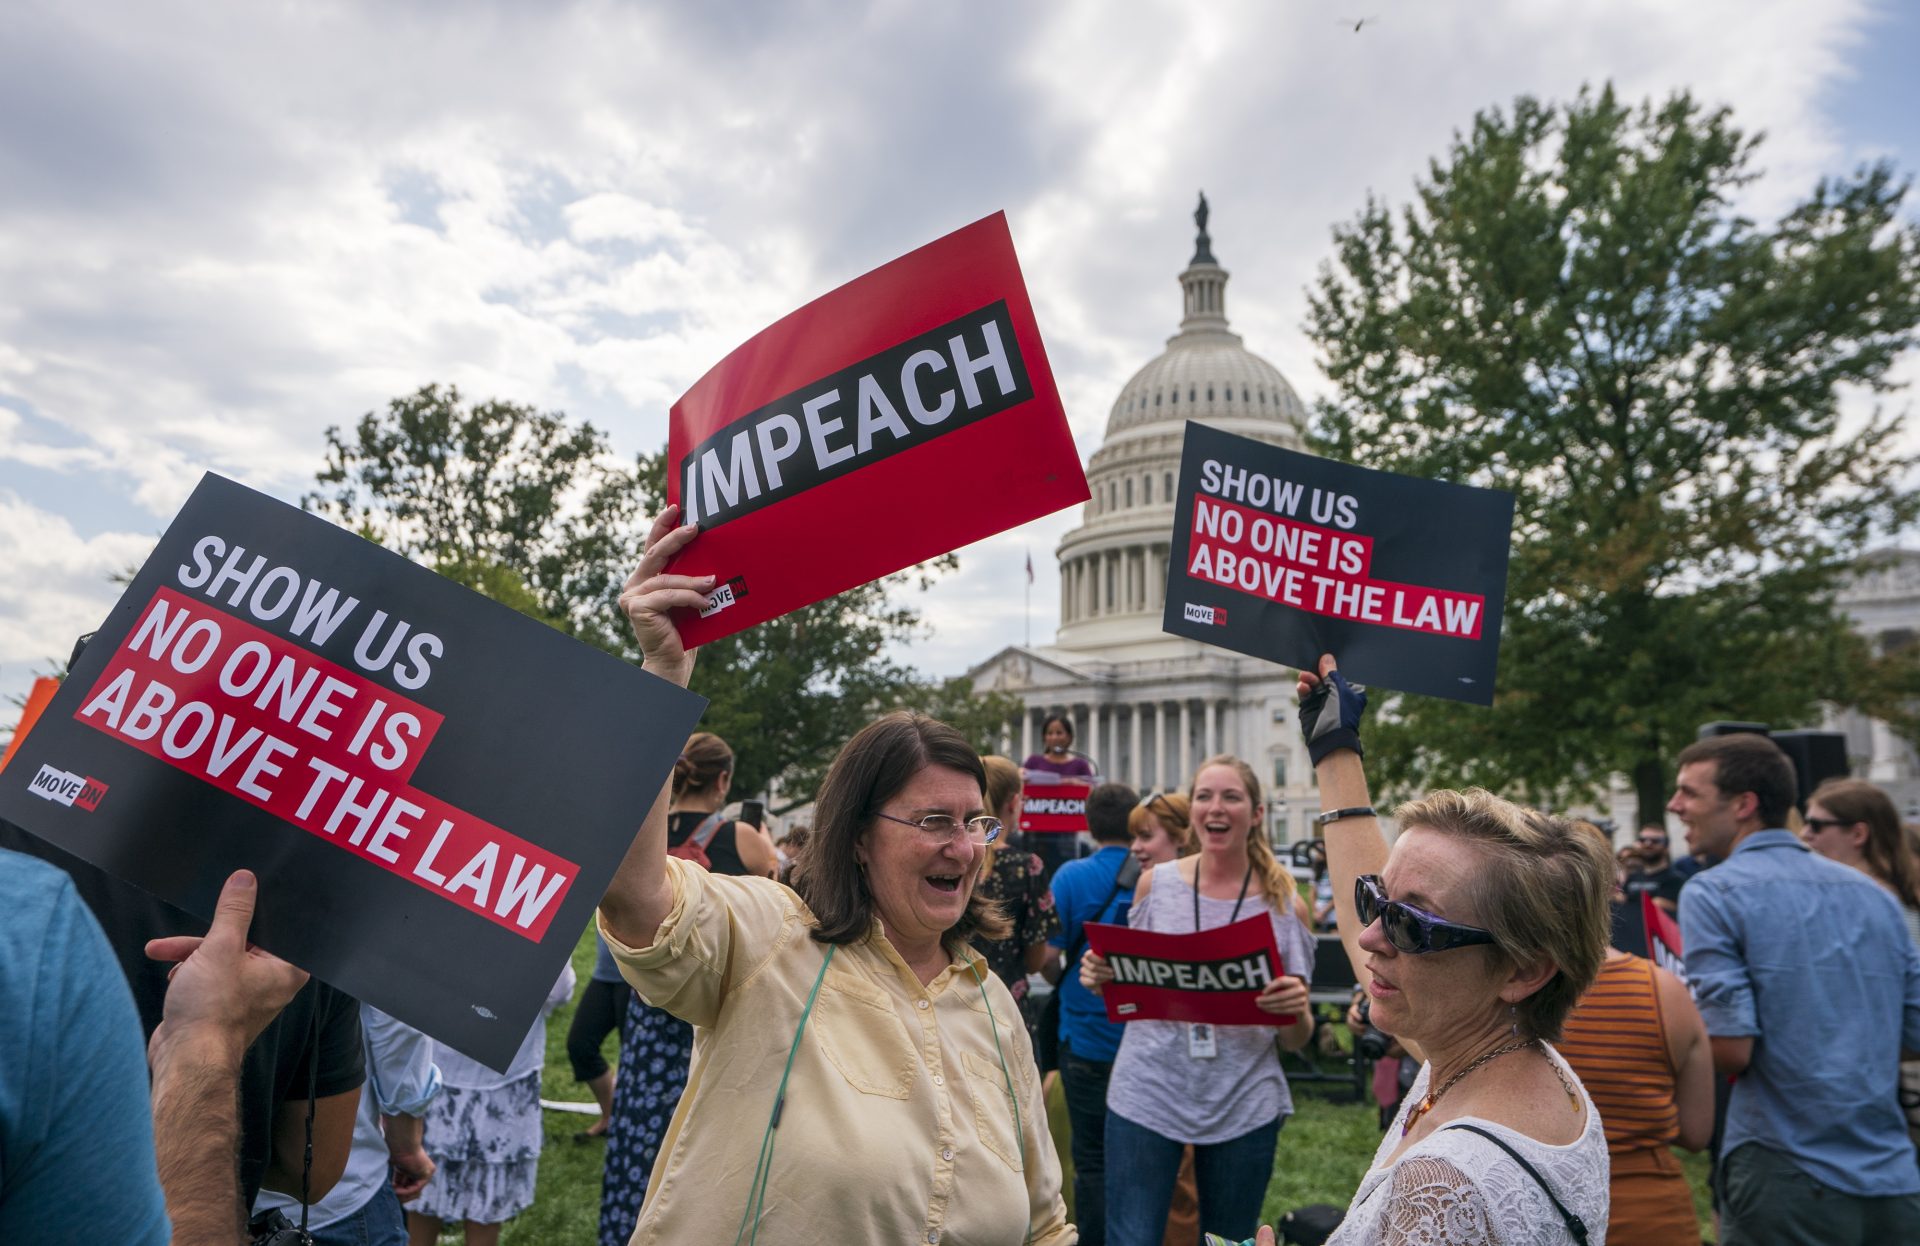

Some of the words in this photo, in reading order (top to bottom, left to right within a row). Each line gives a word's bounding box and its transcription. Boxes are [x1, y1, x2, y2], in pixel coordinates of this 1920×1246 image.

[686, 319, 1017, 526] IMPEACH
[1195, 500, 1244, 544] NO
[1250, 518, 1322, 566] ONE
[1327, 537, 1364, 575] IS
[1200, 459, 1304, 516] SHOW
[1310, 488, 1359, 529] US
[177, 535, 361, 647] SHOW
[353, 609, 444, 690] US
[1189, 543, 1305, 605] ABOVE
[1311, 575, 1386, 622] THE
[1392, 590, 1480, 635] LAW
[127, 598, 222, 674] NO
[219, 640, 358, 741] ONE
[346, 699, 421, 771] IS
[80, 668, 299, 802] ABOVE
[294, 756, 426, 864] THE
[412, 818, 567, 929] LAW
[1023, 799, 1086, 815] IMPEACH
[1109, 954, 1272, 991] IMPEACH
